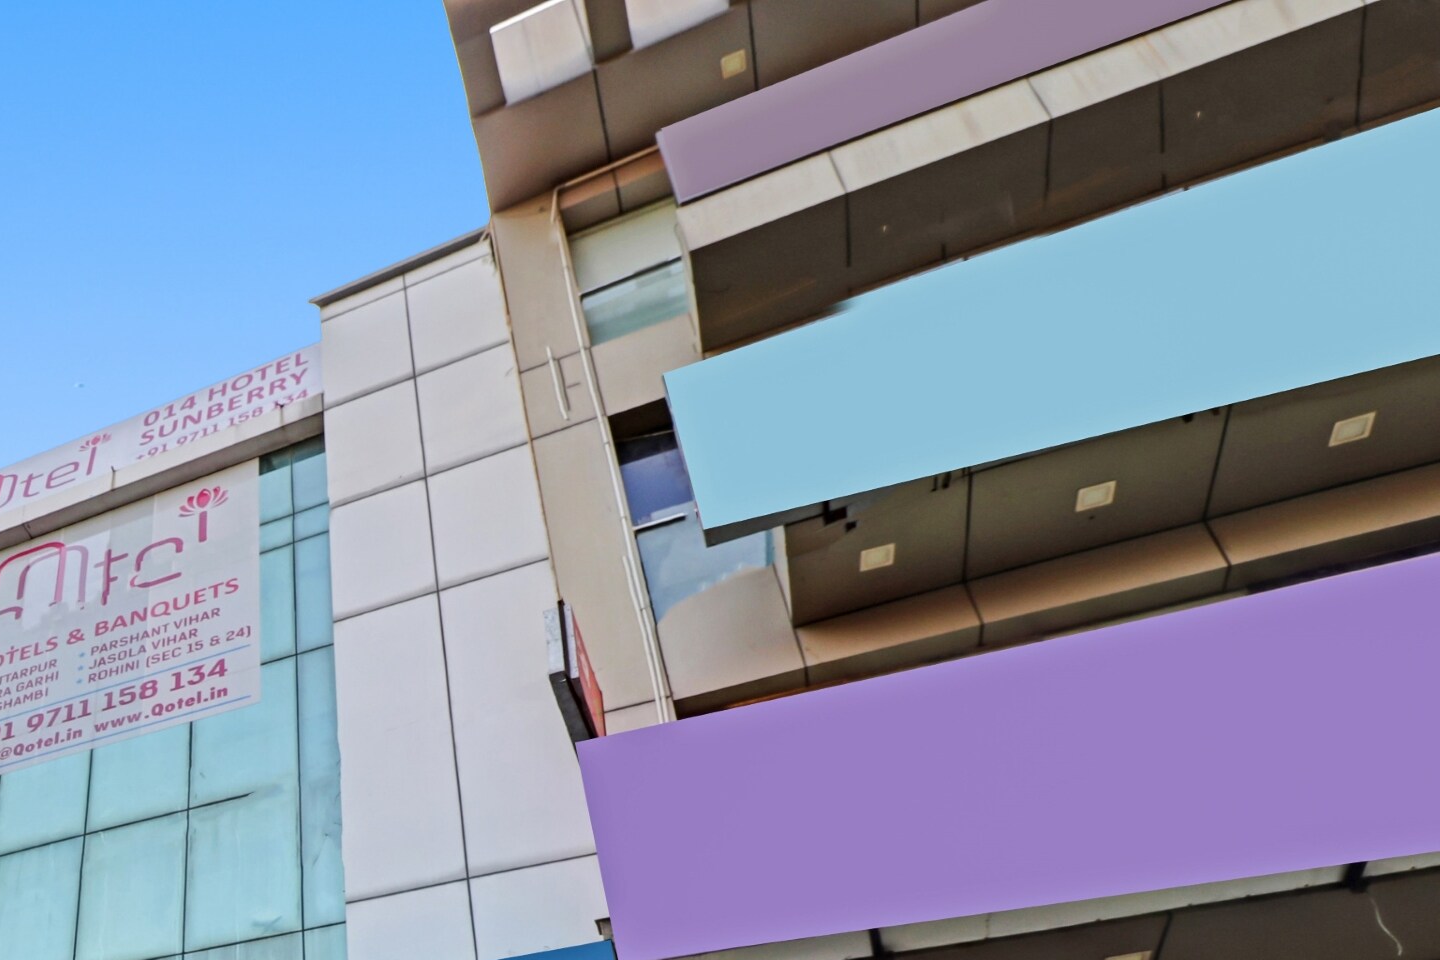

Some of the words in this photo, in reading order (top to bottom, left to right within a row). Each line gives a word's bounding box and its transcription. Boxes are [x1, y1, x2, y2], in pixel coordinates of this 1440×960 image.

[139, 367, 309, 446] SUNBERRY
[143, 395, 197, 427] 014
[207, 352, 309, 403] HOTEL
[136, 443, 168, 460] +91
[176, 423, 220, 446] 9711
[228, 406, 263, 428] 158
[66, 628, 85, 646] &
[94, 577, 240, 637] BANQUETS
[90, 622, 170, 656] PARSHANT
[173, 607, 221, 630] VIHAR
[88, 644, 147, 670] JASOLA
[151, 628, 199, 650] VIHAR
[88, 660, 140, 684] ROHINI
[146, 646, 182, 668] (SEC
[186, 640, 204, 655] 15
[209, 635, 221, 647] &
[226, 625, 252, 642] 24)
[15, 671, 59, 692] GARHI
[26, 699, 92, 734] 9711
[101, 679, 158, 712] 158
[169, 658, 228, 692] 134
